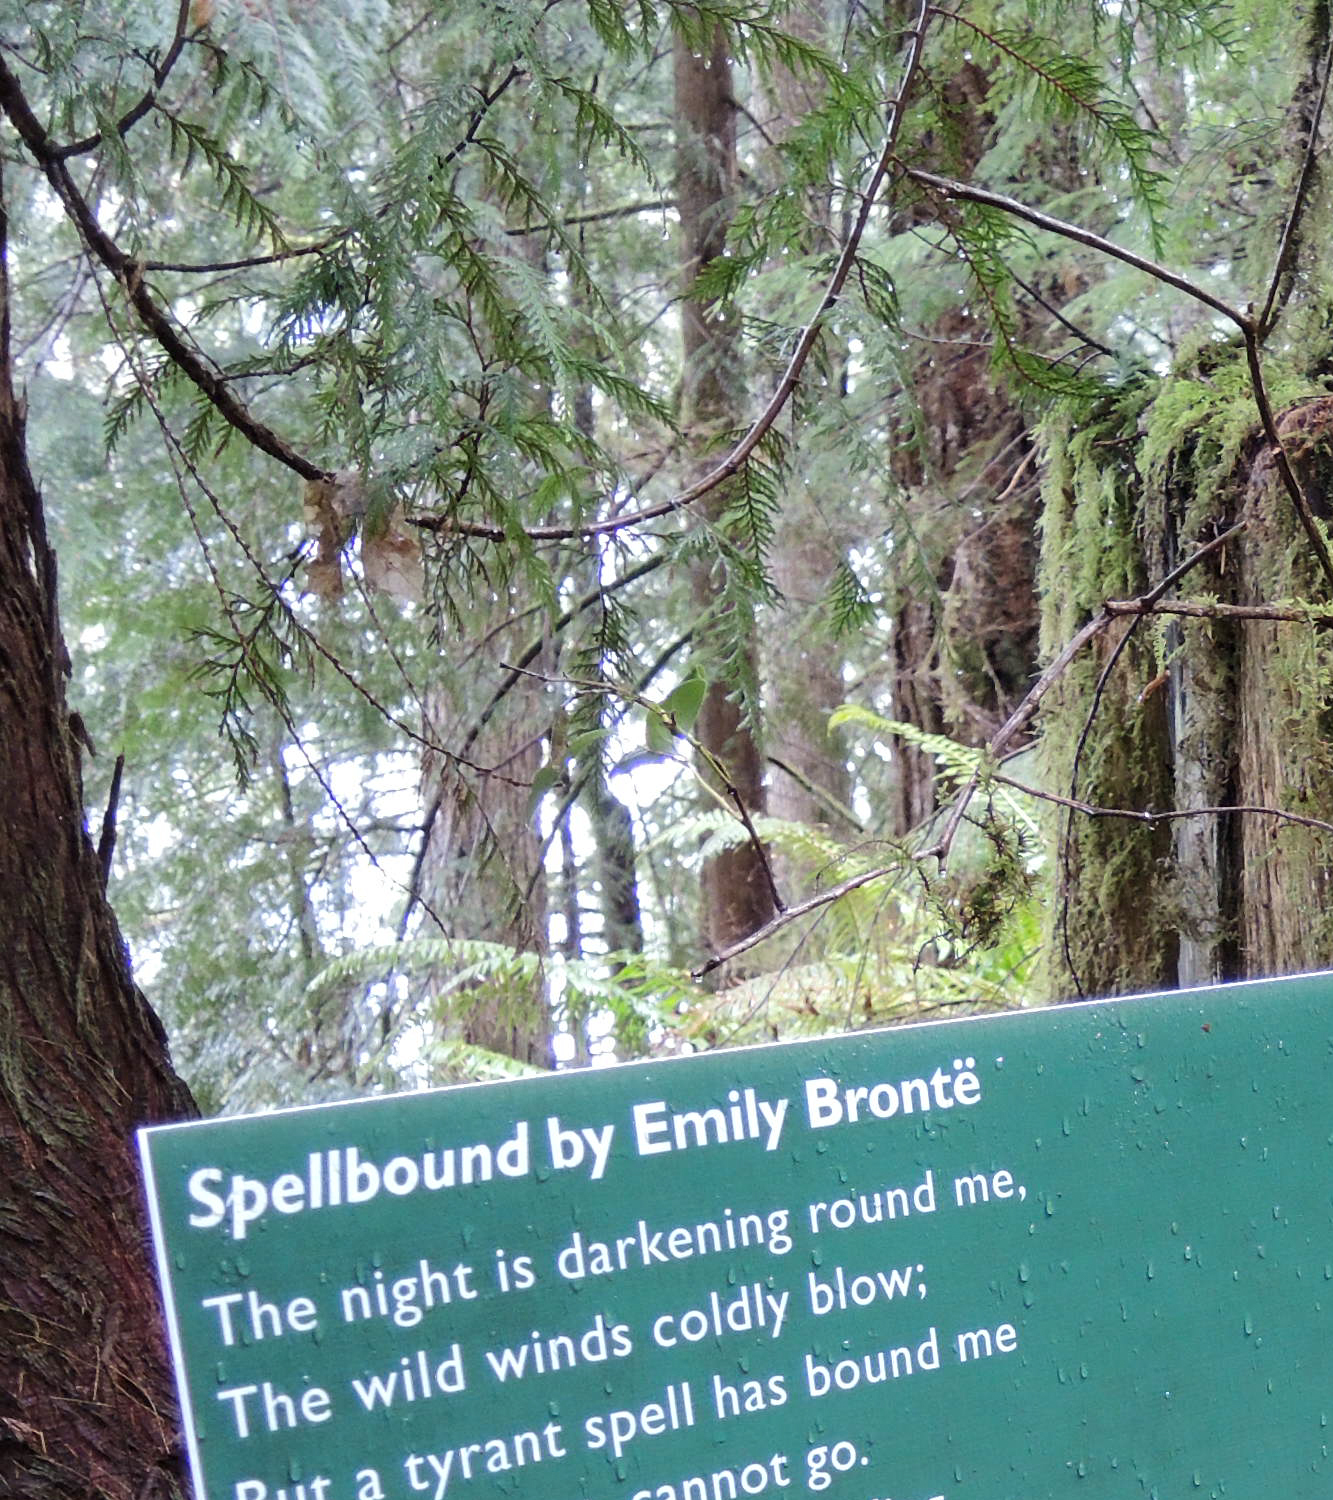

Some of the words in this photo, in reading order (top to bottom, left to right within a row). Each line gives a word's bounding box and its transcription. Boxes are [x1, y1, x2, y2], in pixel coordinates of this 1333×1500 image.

[187, 1121, 530, 1240] Spellbound
[546, 1117, 616, 1179] by
[633, 1088, 788, 1155] Emily
[805, 1057, 981, 1128] Brontë
[202, 1291, 317, 1345] The
[342, 1260, 477, 1327] night
[496, 1249, 535, 1292] is
[558, 1208, 792, 1279] darkening
[809, 1170, 936, 1233] round
[955, 1170, 1026, 1206] me,
[217, 1382, 331, 1437] The
[352, 1344, 465, 1410] wild
[486, 1315, 632, 1382] winds
[654, 1283, 789, 1347] coldly
[808, 1264, 926, 1314] blow;
[404, 1422, 566, 1500] tyrant
[585, 1382, 694, 1457] spell
[714, 1375, 787, 1418] has
[806, 1327, 940, 1396] bound
[958, 1324, 1017, 1362] me
[807, 1441, 868, 1490] go.
